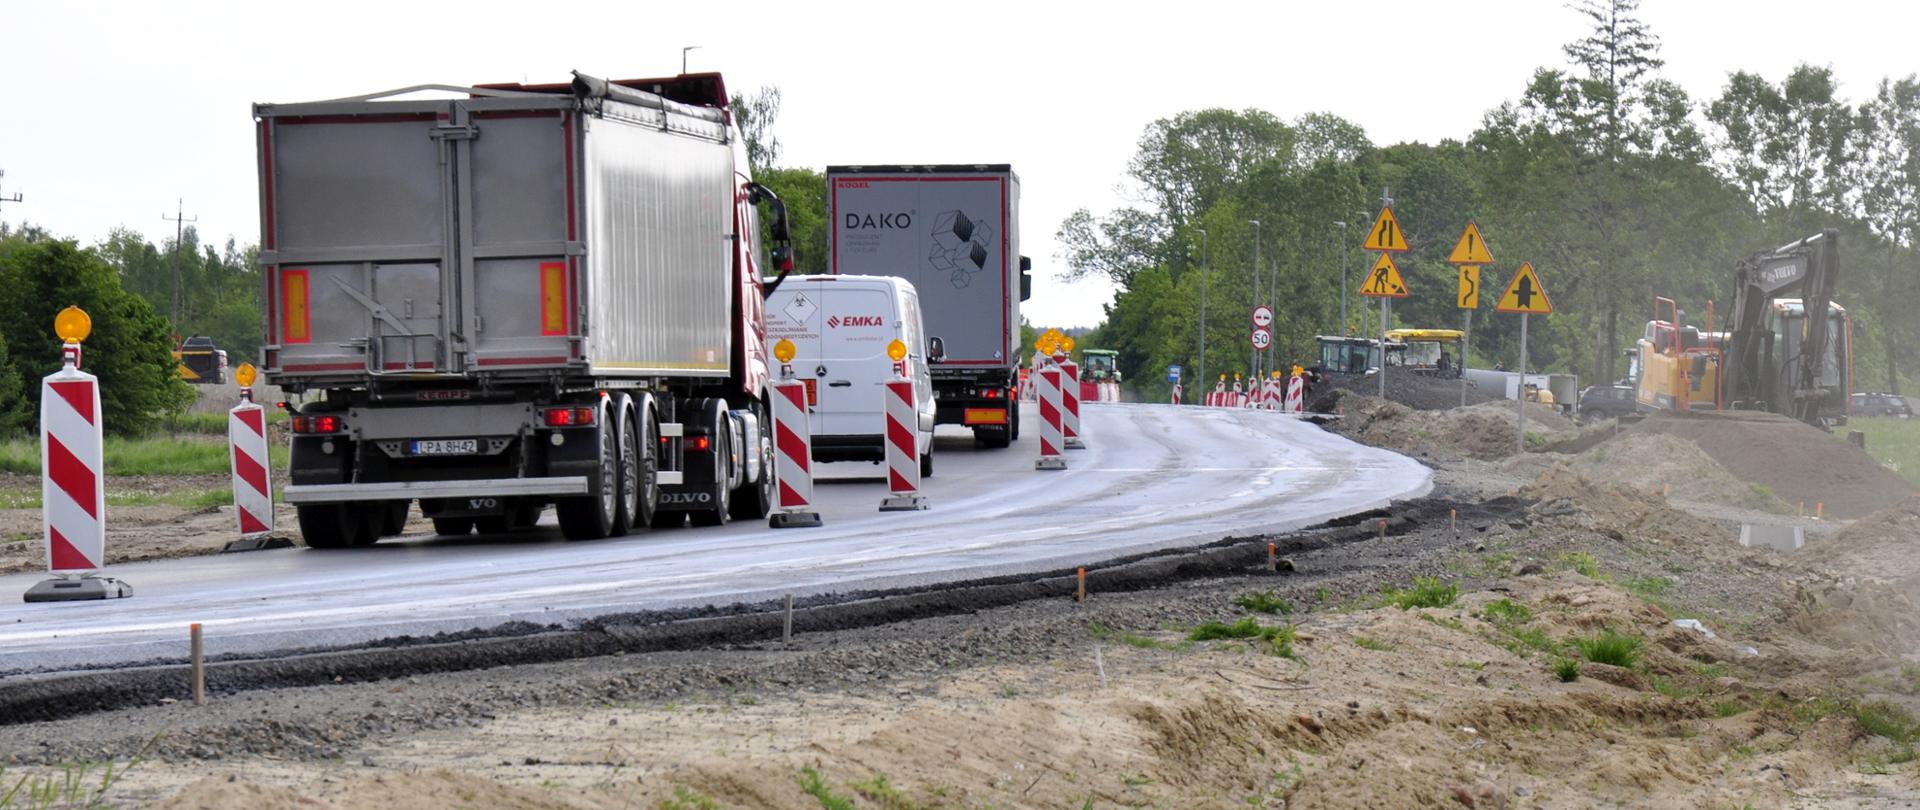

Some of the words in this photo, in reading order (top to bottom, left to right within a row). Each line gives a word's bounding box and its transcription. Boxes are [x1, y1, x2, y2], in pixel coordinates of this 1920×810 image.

[846, 212, 911, 229] DAKO
[843, 316, 882, 326] EMKA
[1254, 333, 1268, 344] 50
[416, 390, 470, 400] KEMPF
[660, 492, 711, 504] OLVO
